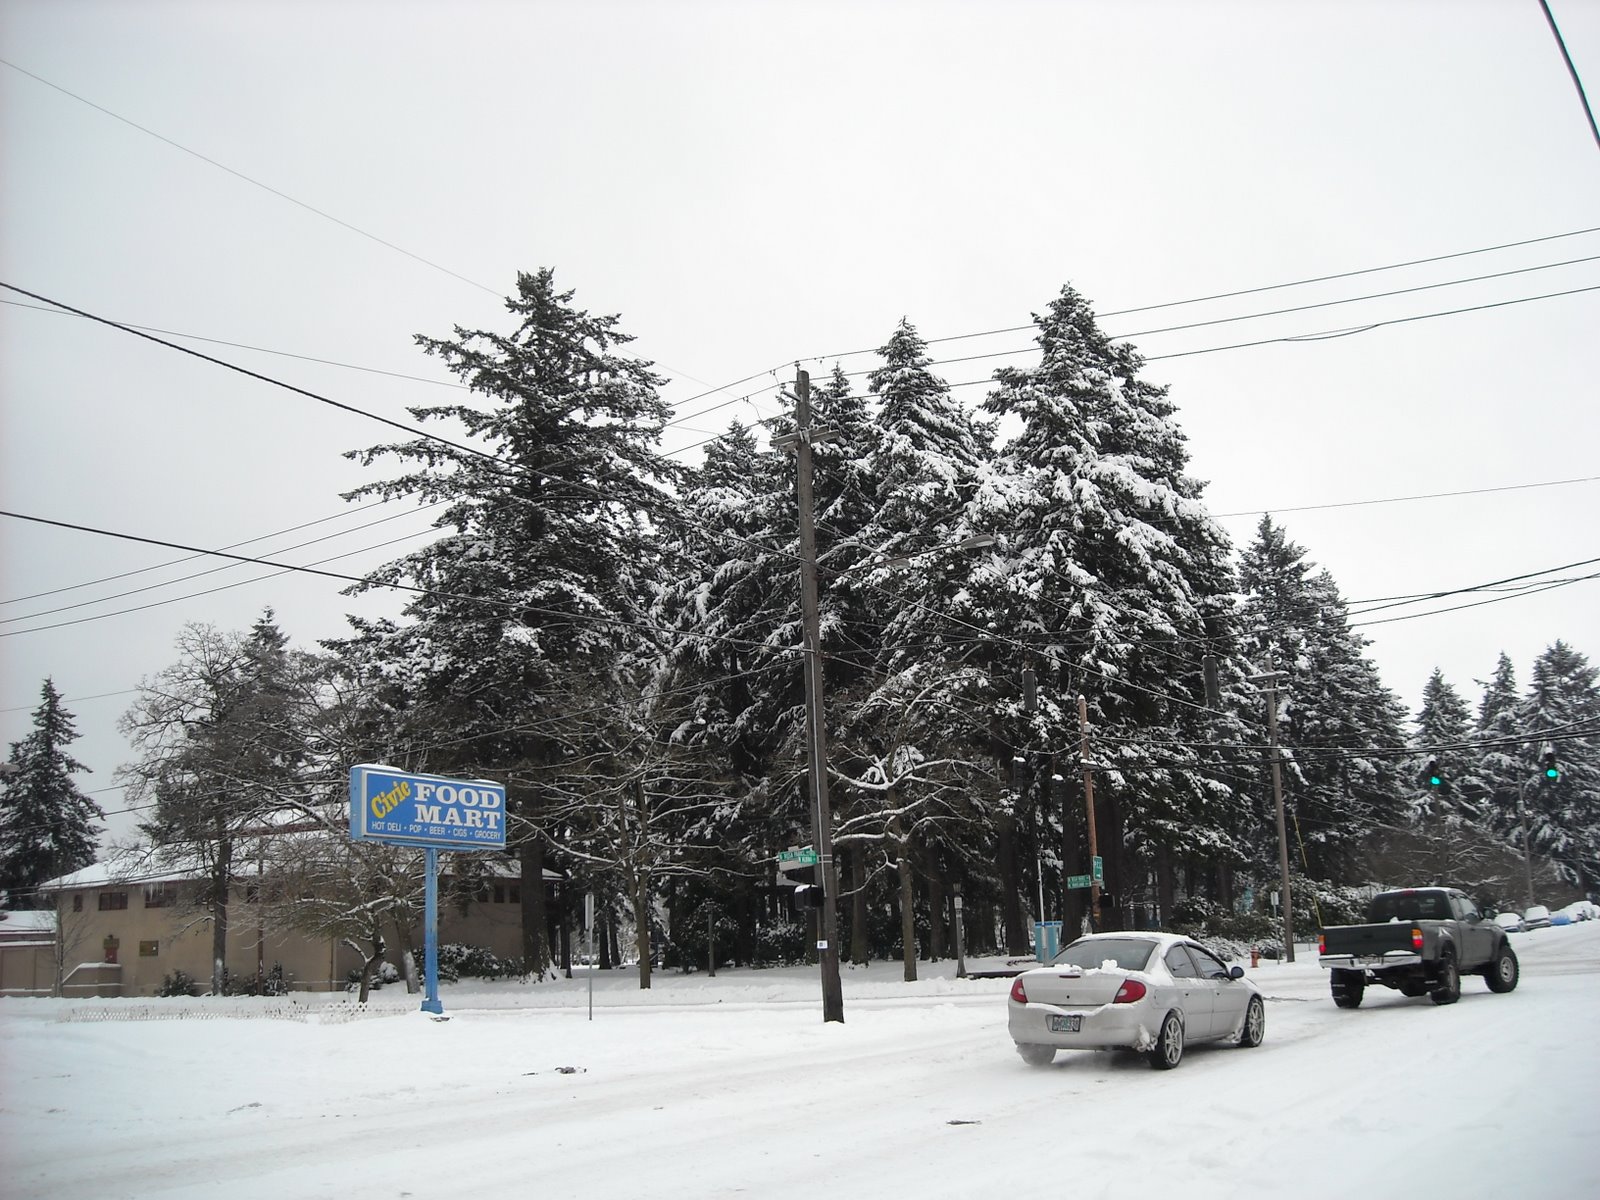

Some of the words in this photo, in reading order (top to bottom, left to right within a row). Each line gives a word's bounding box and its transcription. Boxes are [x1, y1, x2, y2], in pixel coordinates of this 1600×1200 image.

[371, 781, 411, 819] Civic
[414, 782, 500, 809] FOOD
[414, 804, 500, 829] MART
[371, 821, 385, 830] HOT
[387, 822, 401, 832] DELI
[409, 824, 422, 833] POP
[429, 826, 445, 835] BEER
[453, 828, 467, 837] CIGS
[474, 830, 501, 840] GROCERY
